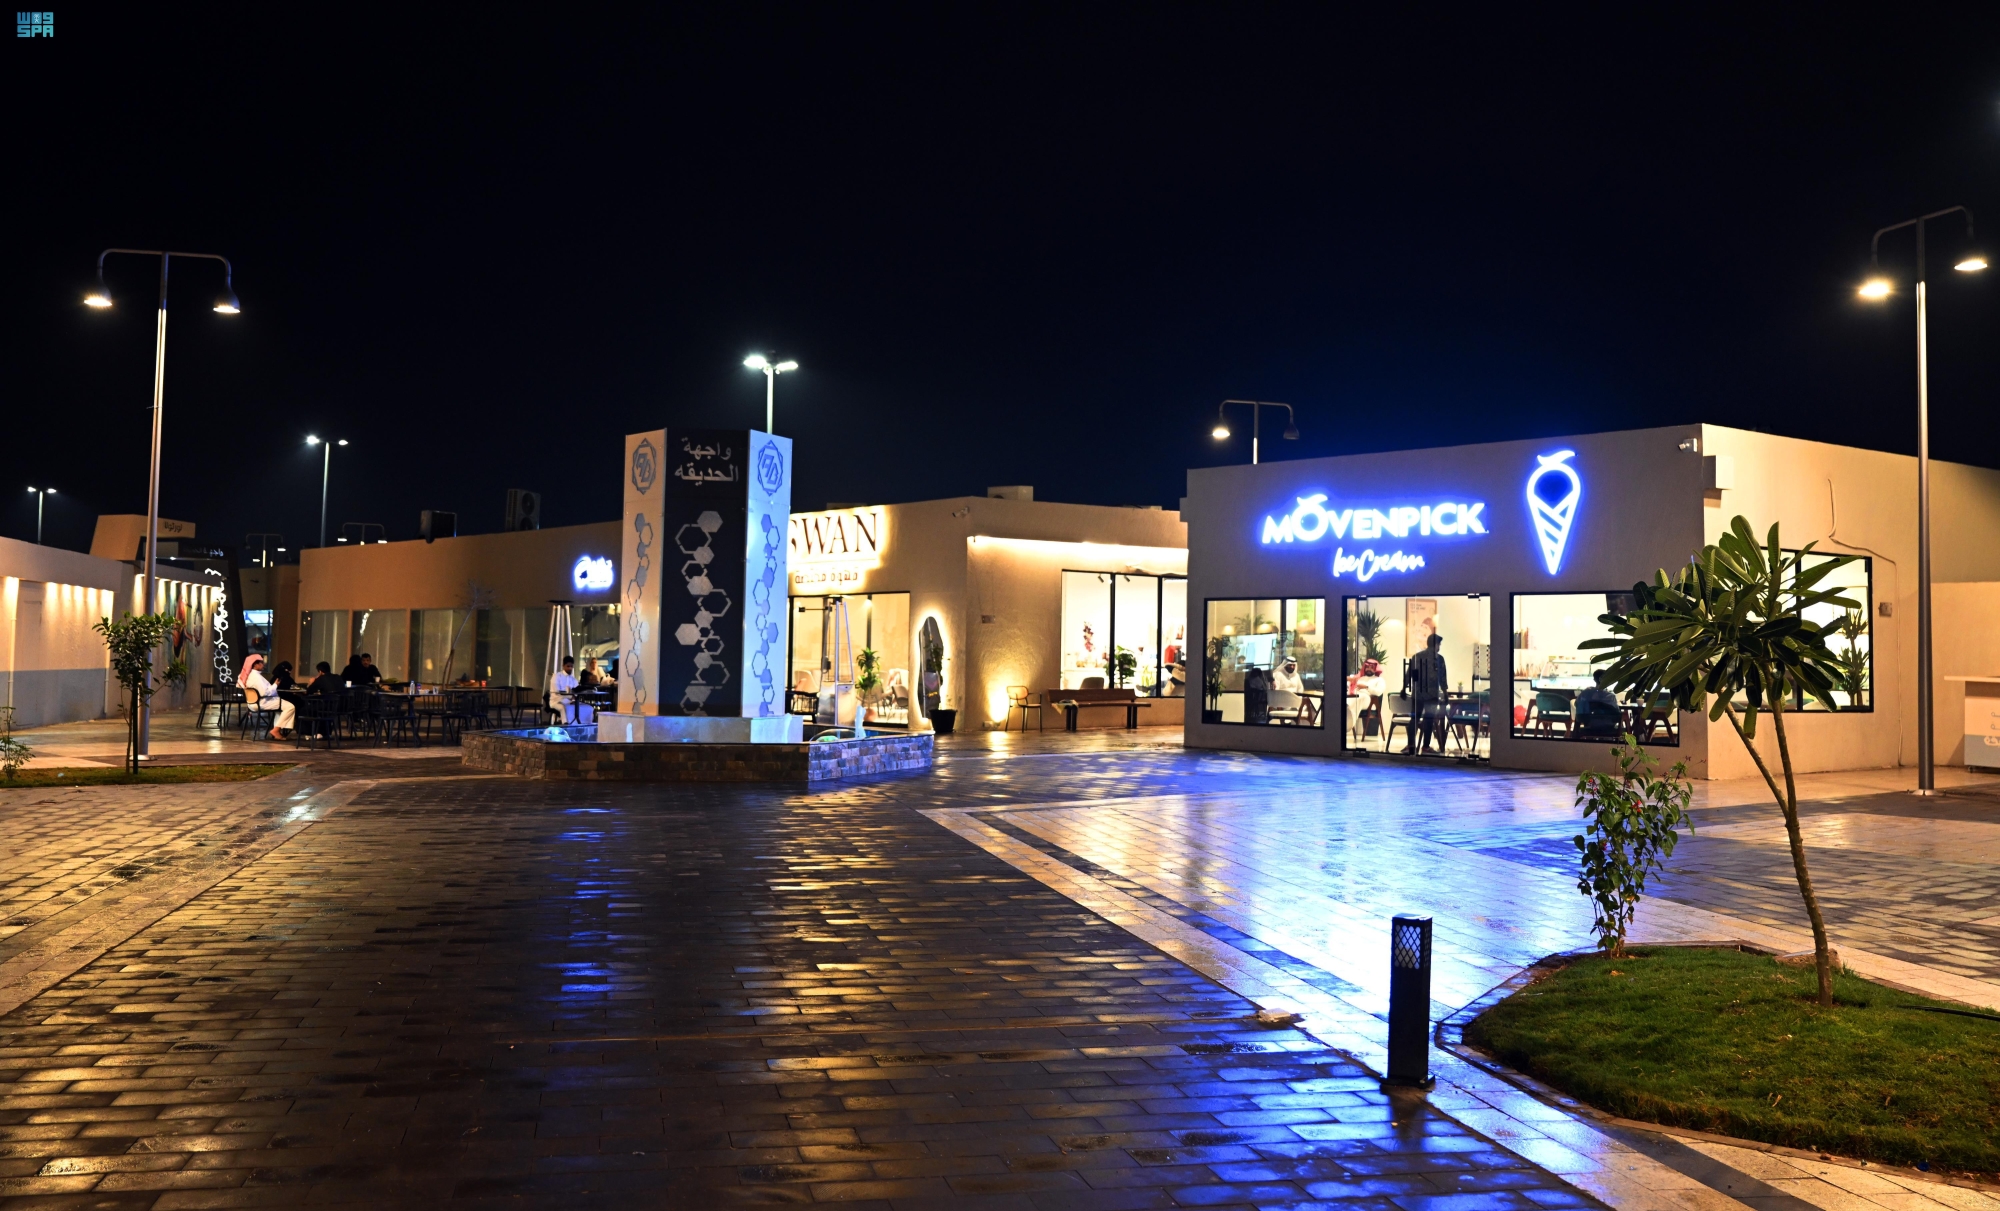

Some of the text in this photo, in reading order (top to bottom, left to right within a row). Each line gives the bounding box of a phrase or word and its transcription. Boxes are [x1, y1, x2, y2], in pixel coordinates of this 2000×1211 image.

[681, 437, 732, 460] واجهة
[830, 566, 859, 586] قهوة
[1333, 547, 1425, 582] Ice Cream
